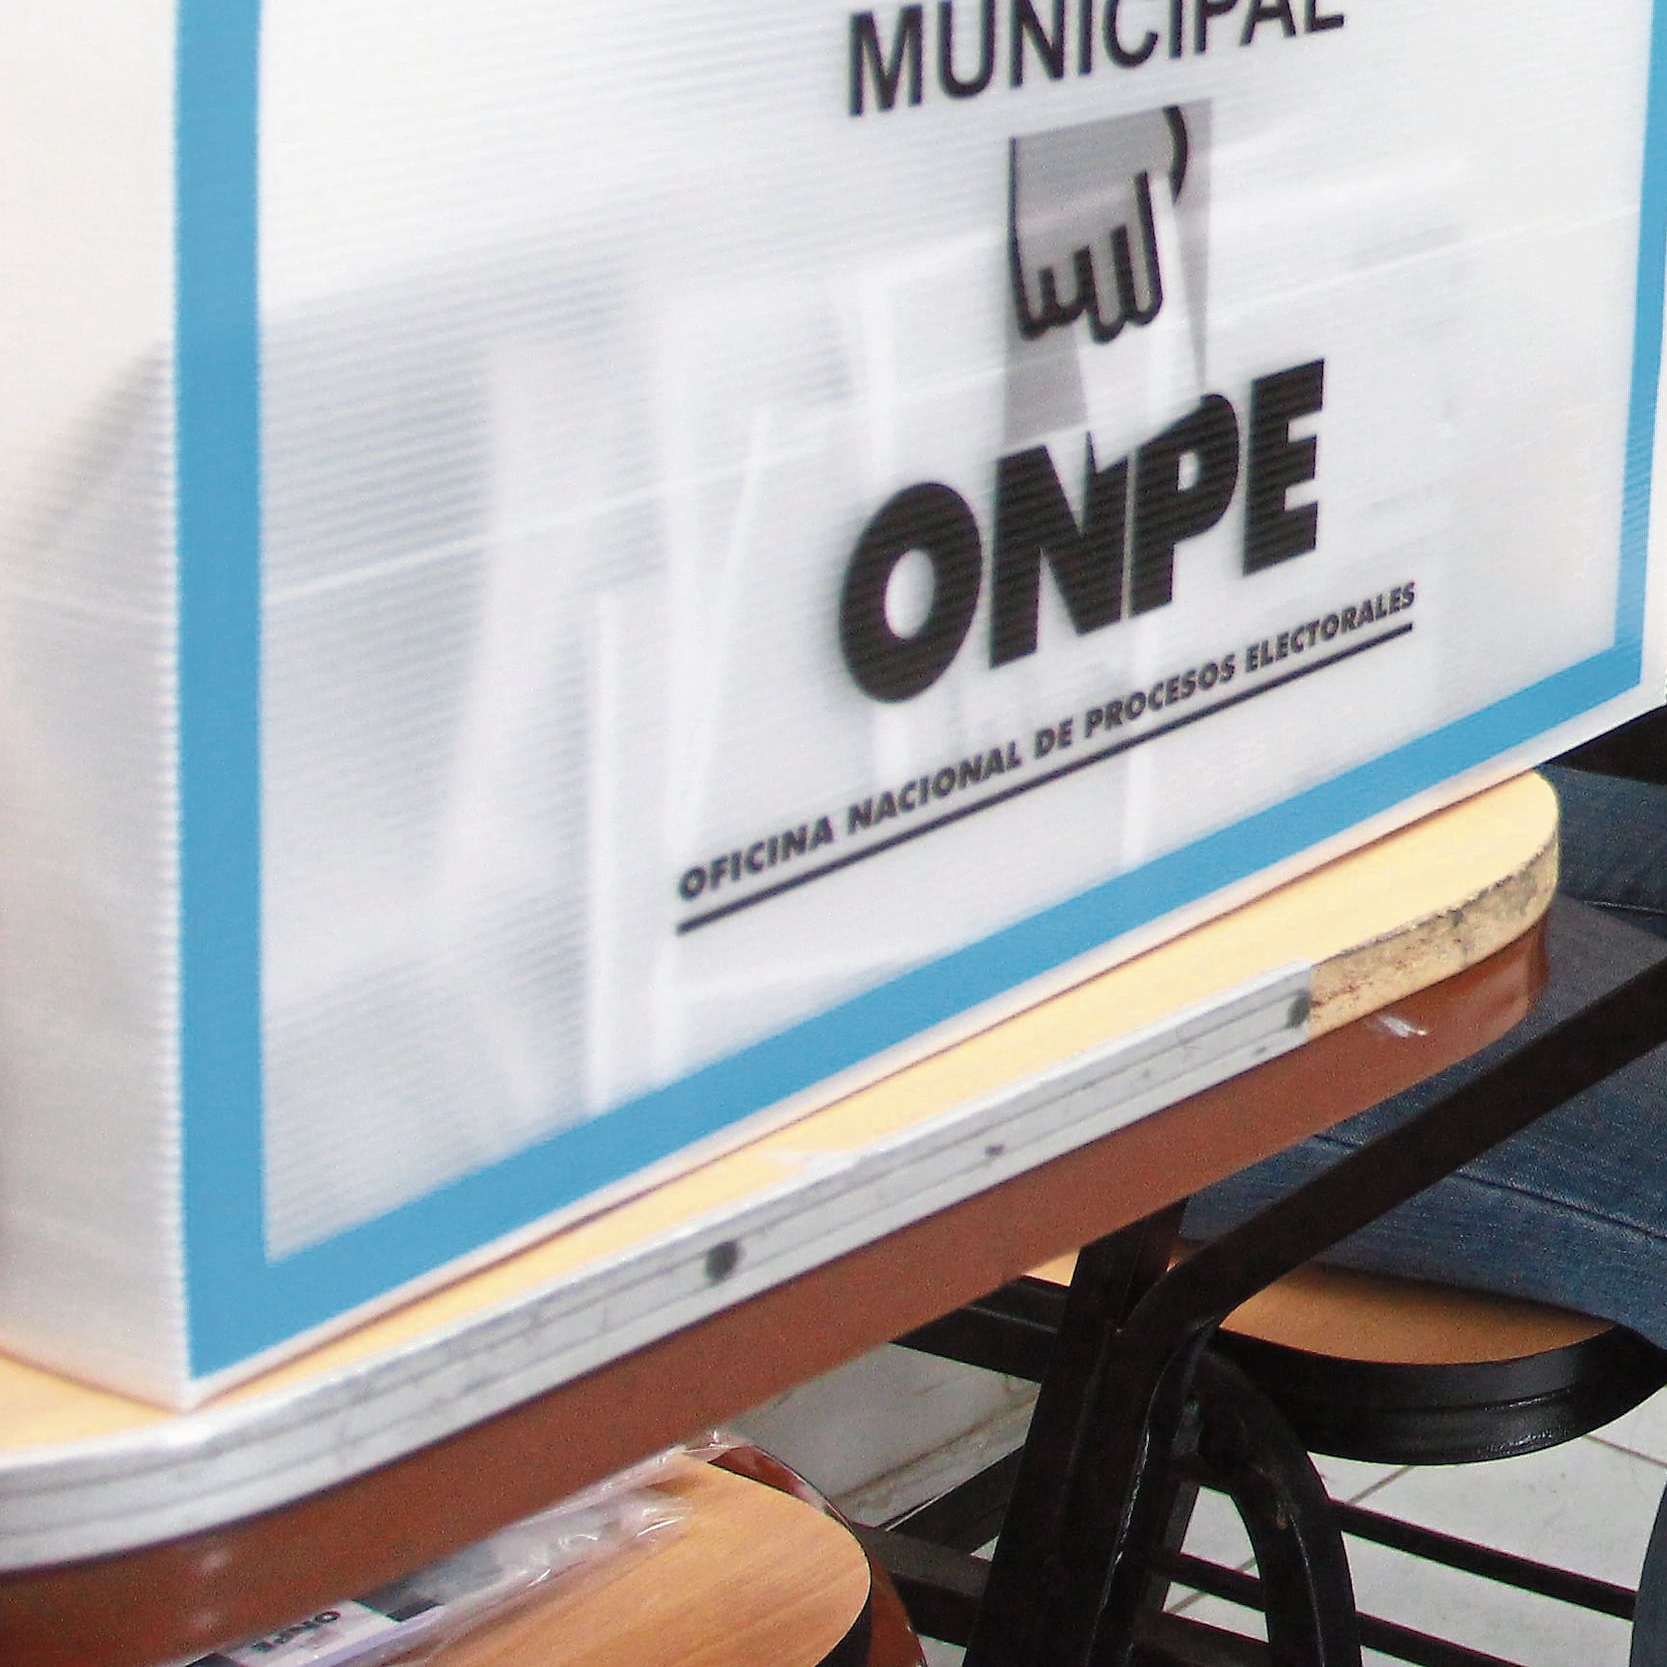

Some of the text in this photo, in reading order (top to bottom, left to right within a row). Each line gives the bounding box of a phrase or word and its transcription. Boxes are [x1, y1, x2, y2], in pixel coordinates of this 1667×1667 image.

[838, 357, 1325, 703] ONPE
[679, 580, 1417, 901] OFICINA NACIONAL DE PROCESOS ELECTORALES
